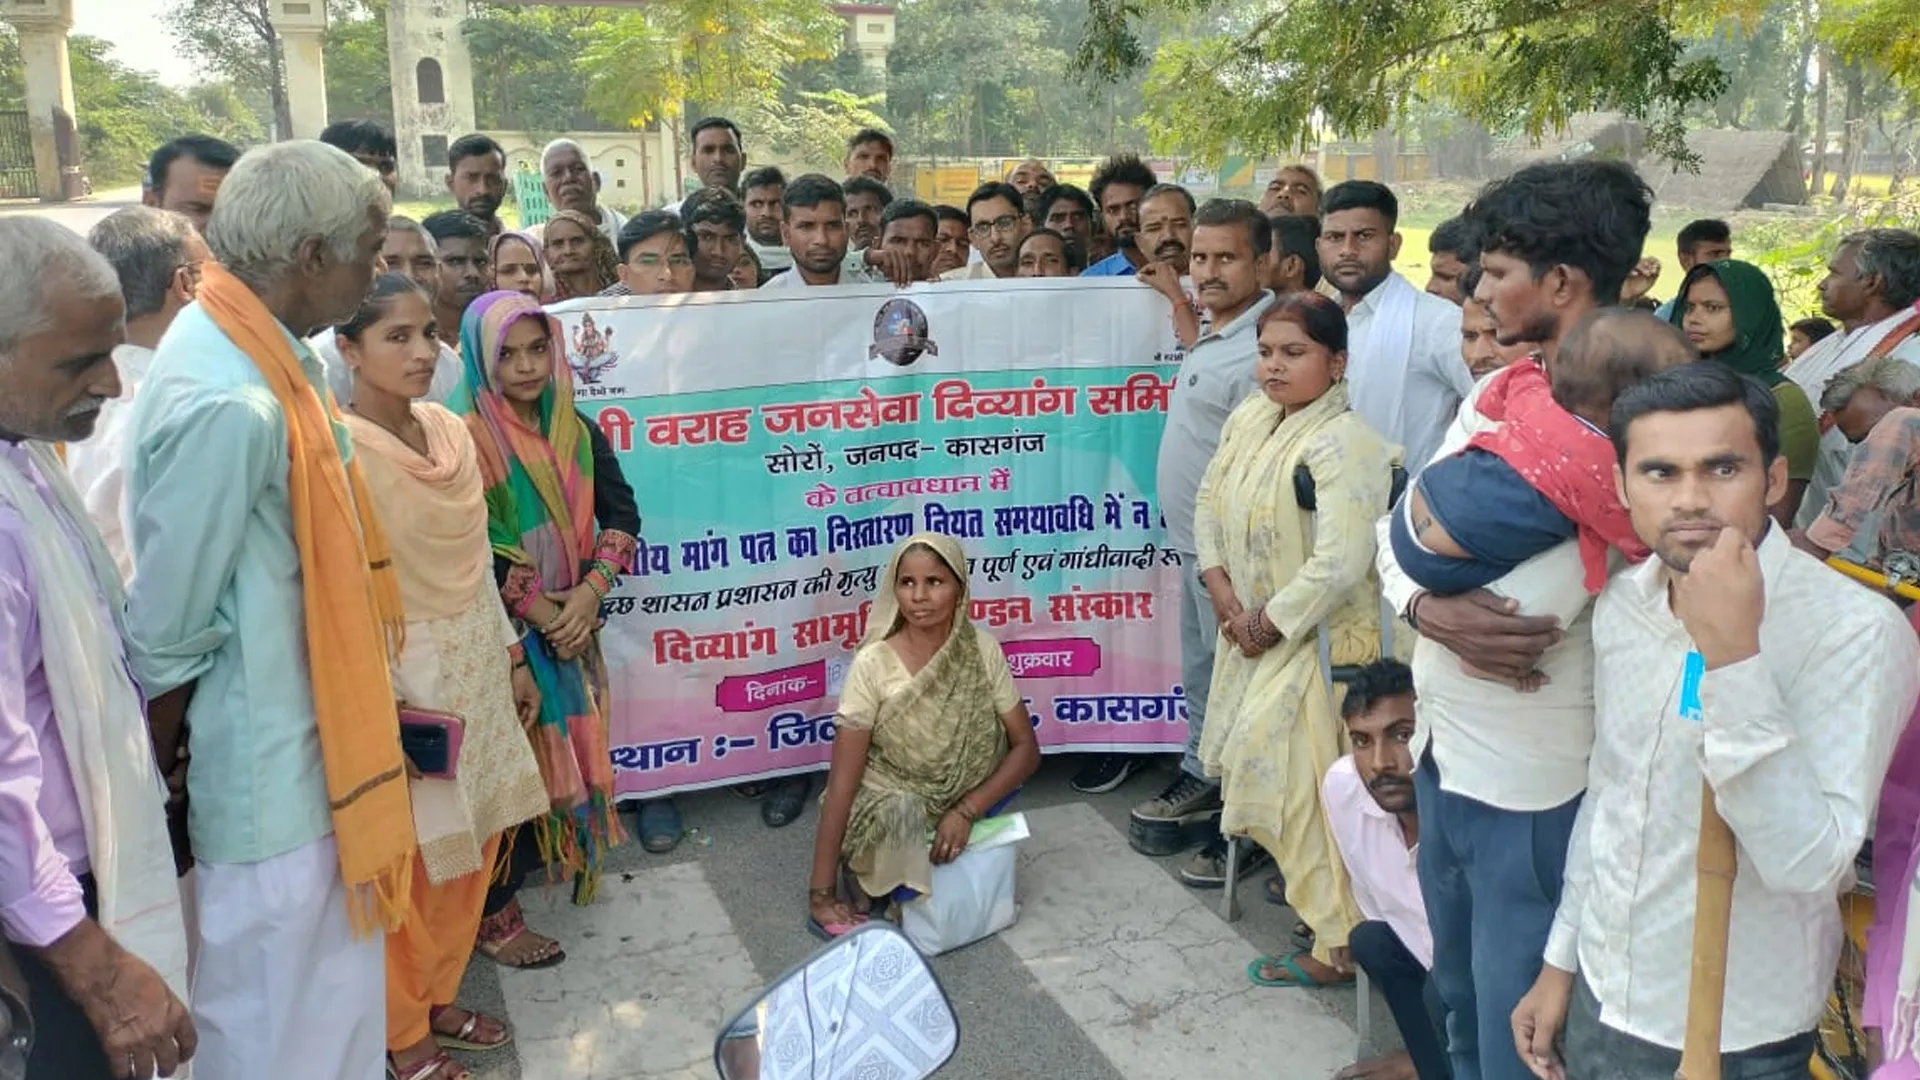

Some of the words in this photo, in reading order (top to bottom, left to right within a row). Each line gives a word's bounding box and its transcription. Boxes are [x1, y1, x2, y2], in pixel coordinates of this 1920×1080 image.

[646, 410, 752, 447] वराह
[761, 386, 921, 434] जनसेवा
[932, 378, 1077, 421] दिव्यांग
[1089, 373, 1178, 415] समि
[765, 443, 834, 474] सोरों,
[844, 438, 935, 467] जनपद-
[945, 428, 1046, 458] कासगंज
[806, 482, 838, 509] के
[845, 475, 982, 505] तत्वावधान
[989, 467, 1011, 492] में
[682, 530, 729, 572] मांग
[786, 526, 818, 558] का
[827, 515, 914, 551] निस्तारण
[924, 503, 984, 538] नियत
[994, 494, 1095, 537] समयावधि
[1104, 492, 1124, 530] में
[1132, 501, 1150, 530] न
[604, 596, 637, 615] च्छ
[641, 590, 711, 615] शासन
[717, 578, 797, 610] प्रशासन
[803, 567, 834, 595] की
[837, 565, 880, 597] मृत्यु
[982, 548, 1021, 582] पूर्ण
[1021, 548, 1057, 580] एवं
[1058, 543, 1156, 570] गांधीवादी
[1160, 548, 1182, 567] रू
[653, 621, 778, 665] दिव्यांग
[968, 596, 1033, 627] ण्डन
[1047, 585, 1153, 622] संस्कार
[1007, 650, 1075, 676] शुक्रवार
[1053, 685, 1189, 723] कासगं
[609, 738, 702, 774] थान
[767, 712, 837, 750] जिल
